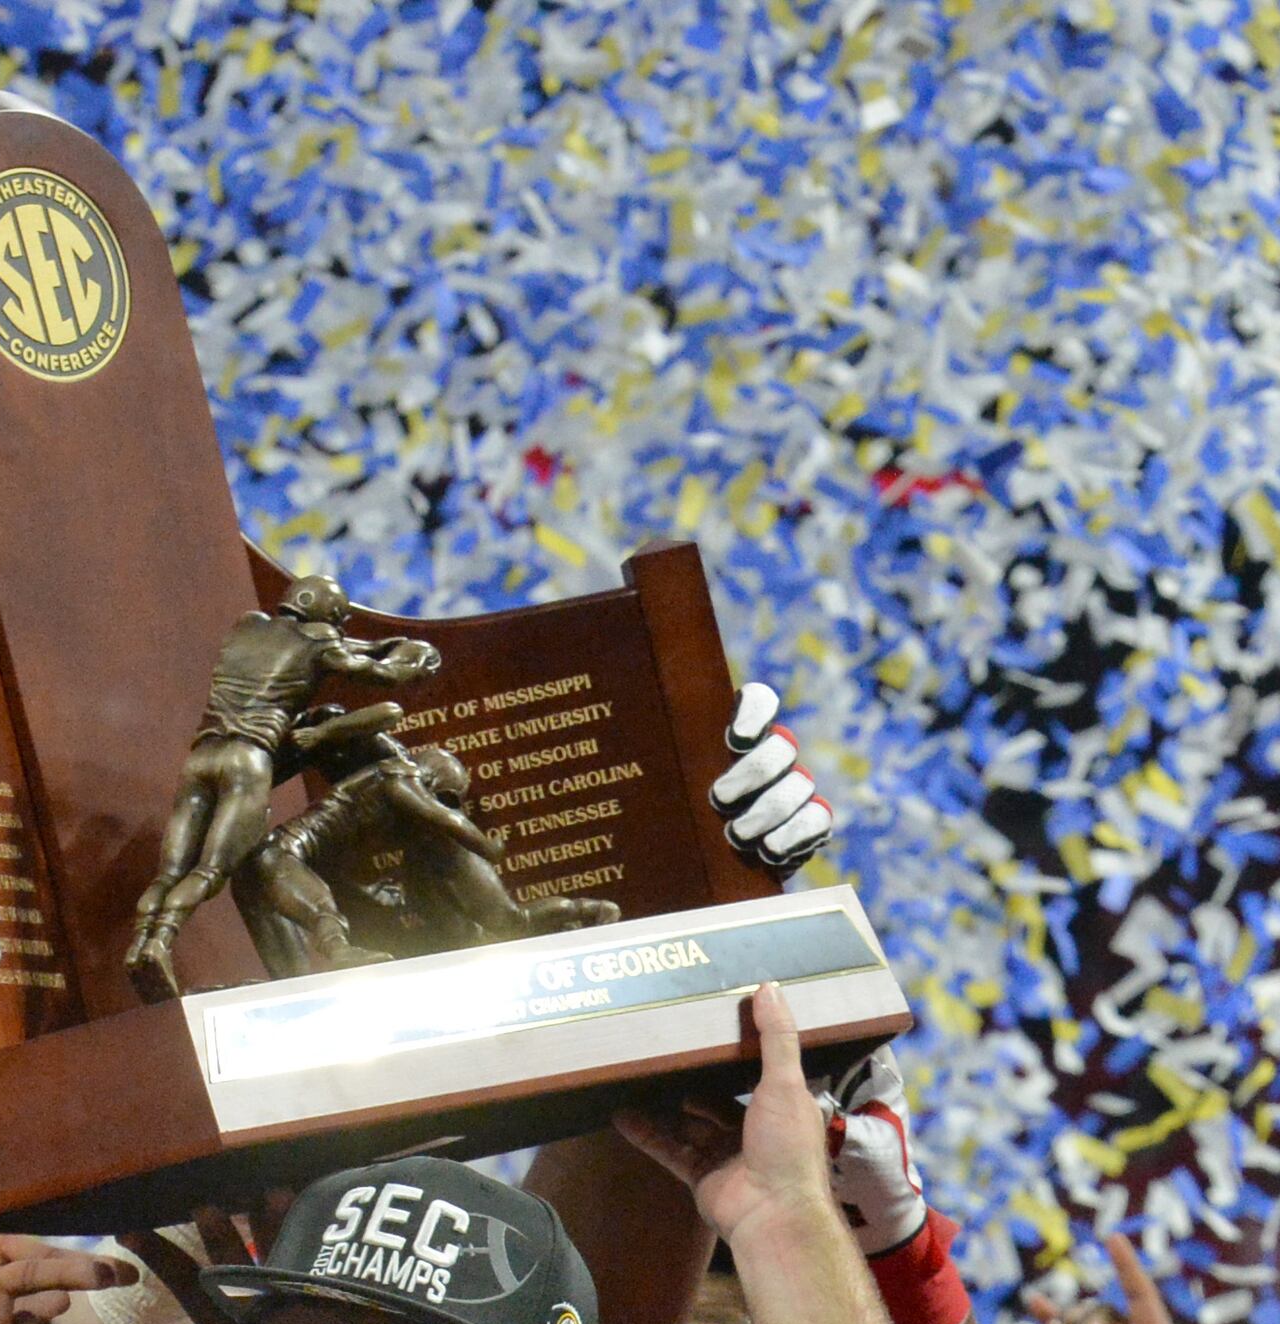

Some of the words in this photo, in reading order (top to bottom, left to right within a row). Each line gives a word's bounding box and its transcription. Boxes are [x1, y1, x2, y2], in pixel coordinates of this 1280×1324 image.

[10, 320, 117, 372] CONFERENCE
[387, 705, 448, 735] RSITY
[454, 700, 479, 719] OF
[484, 674, 592, 712] MISSISSIPPI
[445, 728, 502, 754] STATE
[505, 702, 614, 740] UNIVERSITY
[478, 760, 505, 780] OF
[509, 738, 598, 773] MISSOURI
[479, 783, 546, 812] SOUTH
[548, 761, 644, 796] CAROLINA
[486, 823, 513, 843] OF
[516, 798, 623, 837] TENNESSEE
[505, 833, 615, 872] UNIVERSITY
[516, 863, 625, 901] UNIVERSITY
[536, 960, 576, 990] OF
[582, 939, 711, 982] GEORGIA
[322, 1182, 471, 1268] SEC
[310, 1245, 334, 1276] 2017
[326, 1242, 451, 1304] CHAMPS
